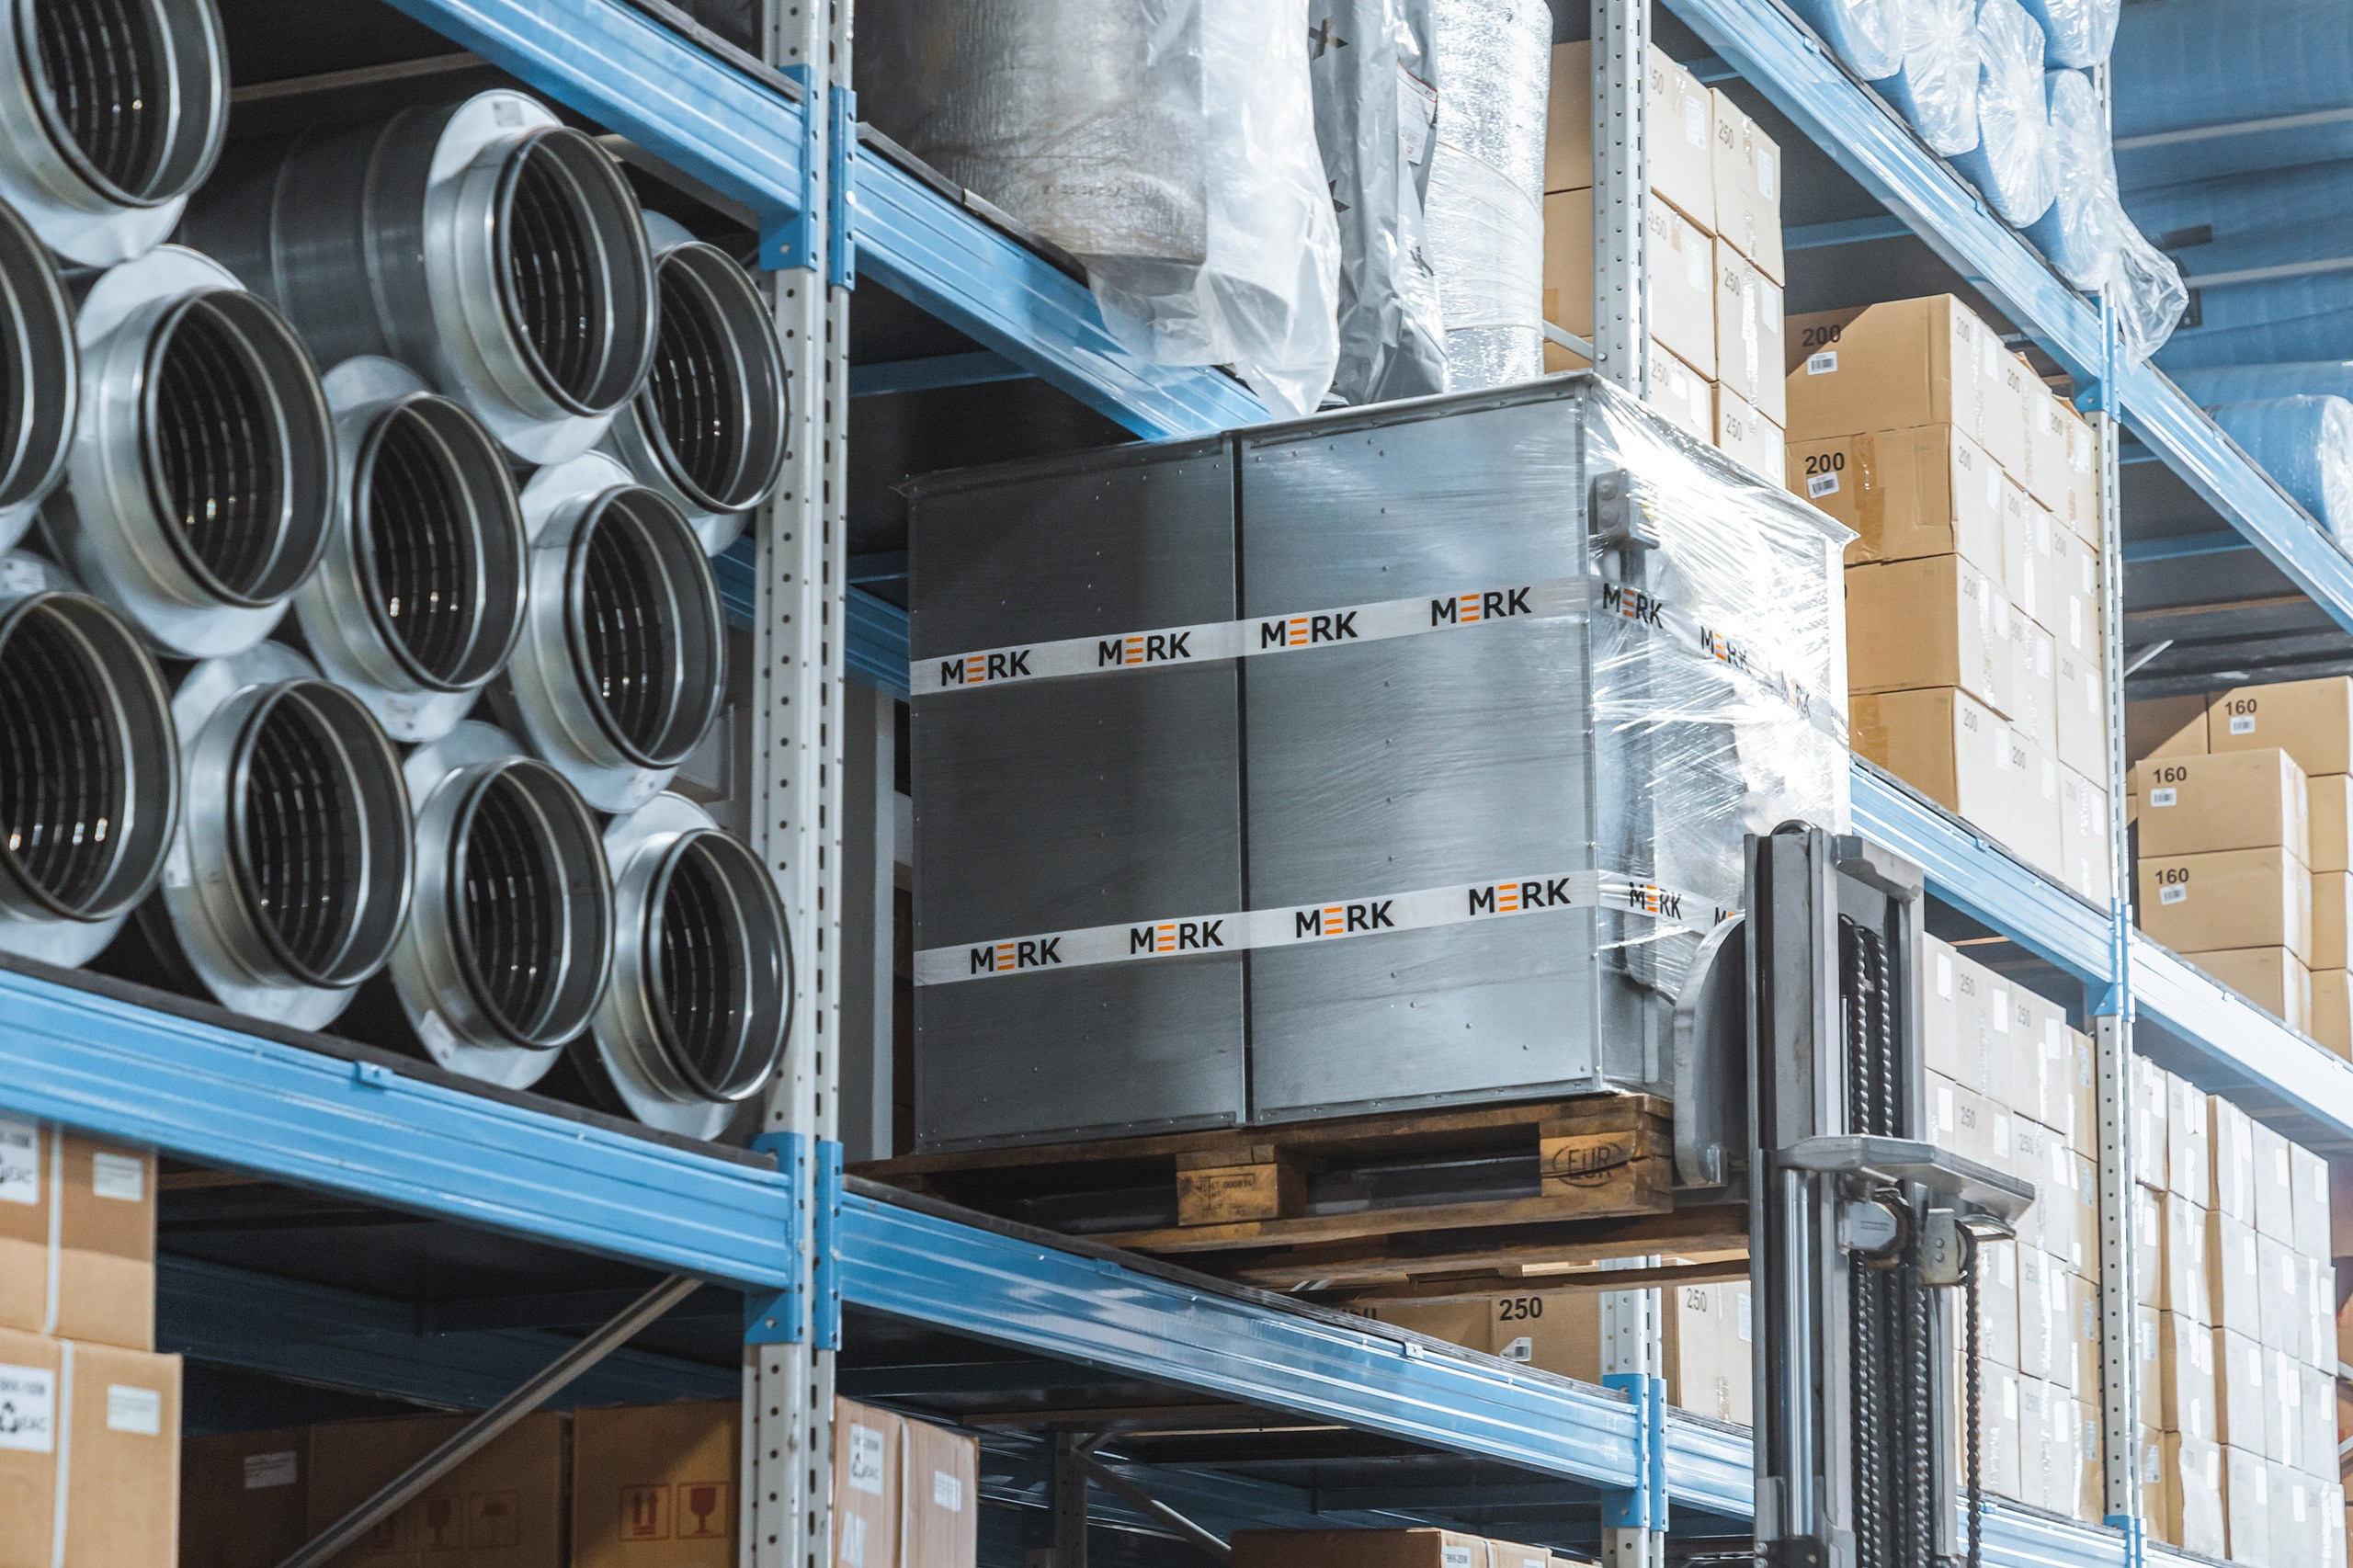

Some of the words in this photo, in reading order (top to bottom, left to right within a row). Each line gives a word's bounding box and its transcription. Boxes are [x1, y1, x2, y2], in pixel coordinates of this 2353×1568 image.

[1650, 66, 1664, 95] 50
[1719, 119, 1734, 149] 250
[1724, 267, 1740, 296] 250
[1802, 324, 1841, 347] 200
[1957, 317, 1970, 343] 200
[1652, 358, 1668, 387] 250
[2007, 369, 2020, 393] 200
[1726, 414, 1742, 442] 250
[2051, 412, 2063, 437] 200
[1805, 452, 1845, 475] 200
[1959, 446, 1972, 471] 200
[1963, 575, 1976, 600] 200
[940, 649, 1031, 687] MERK
[1097, 631, 1191, 667] MERK
[1260, 610, 1358, 649] MERK
[1431, 586, 1532, 627] MERK
[1602, 583, 1664, 629] MERK
[2224, 699, 2257, 716] 160
[2012, 746, 2025, 769] 200
[2153, 767, 2188, 783] 160
[2154, 868, 2189, 884] 160
[970, 937, 1062, 974] MERK
[1130, 919, 1224, 955] MERK
[1295, 900, 1395, 938] MERK
[1469, 878, 1572, 916] MERK
[1629, 881, 1682, 920] MERK
[1960, 973, 1975, 996] 250
[2018, 1005, 2030, 1027] 250
[1961, 1106, 1975, 1129] 250
[1567, 1146, 1610, 1179] EUR
[1499, 1296, 1542, 1321] 250
[1686, 1288, 1707, 1312] 250
